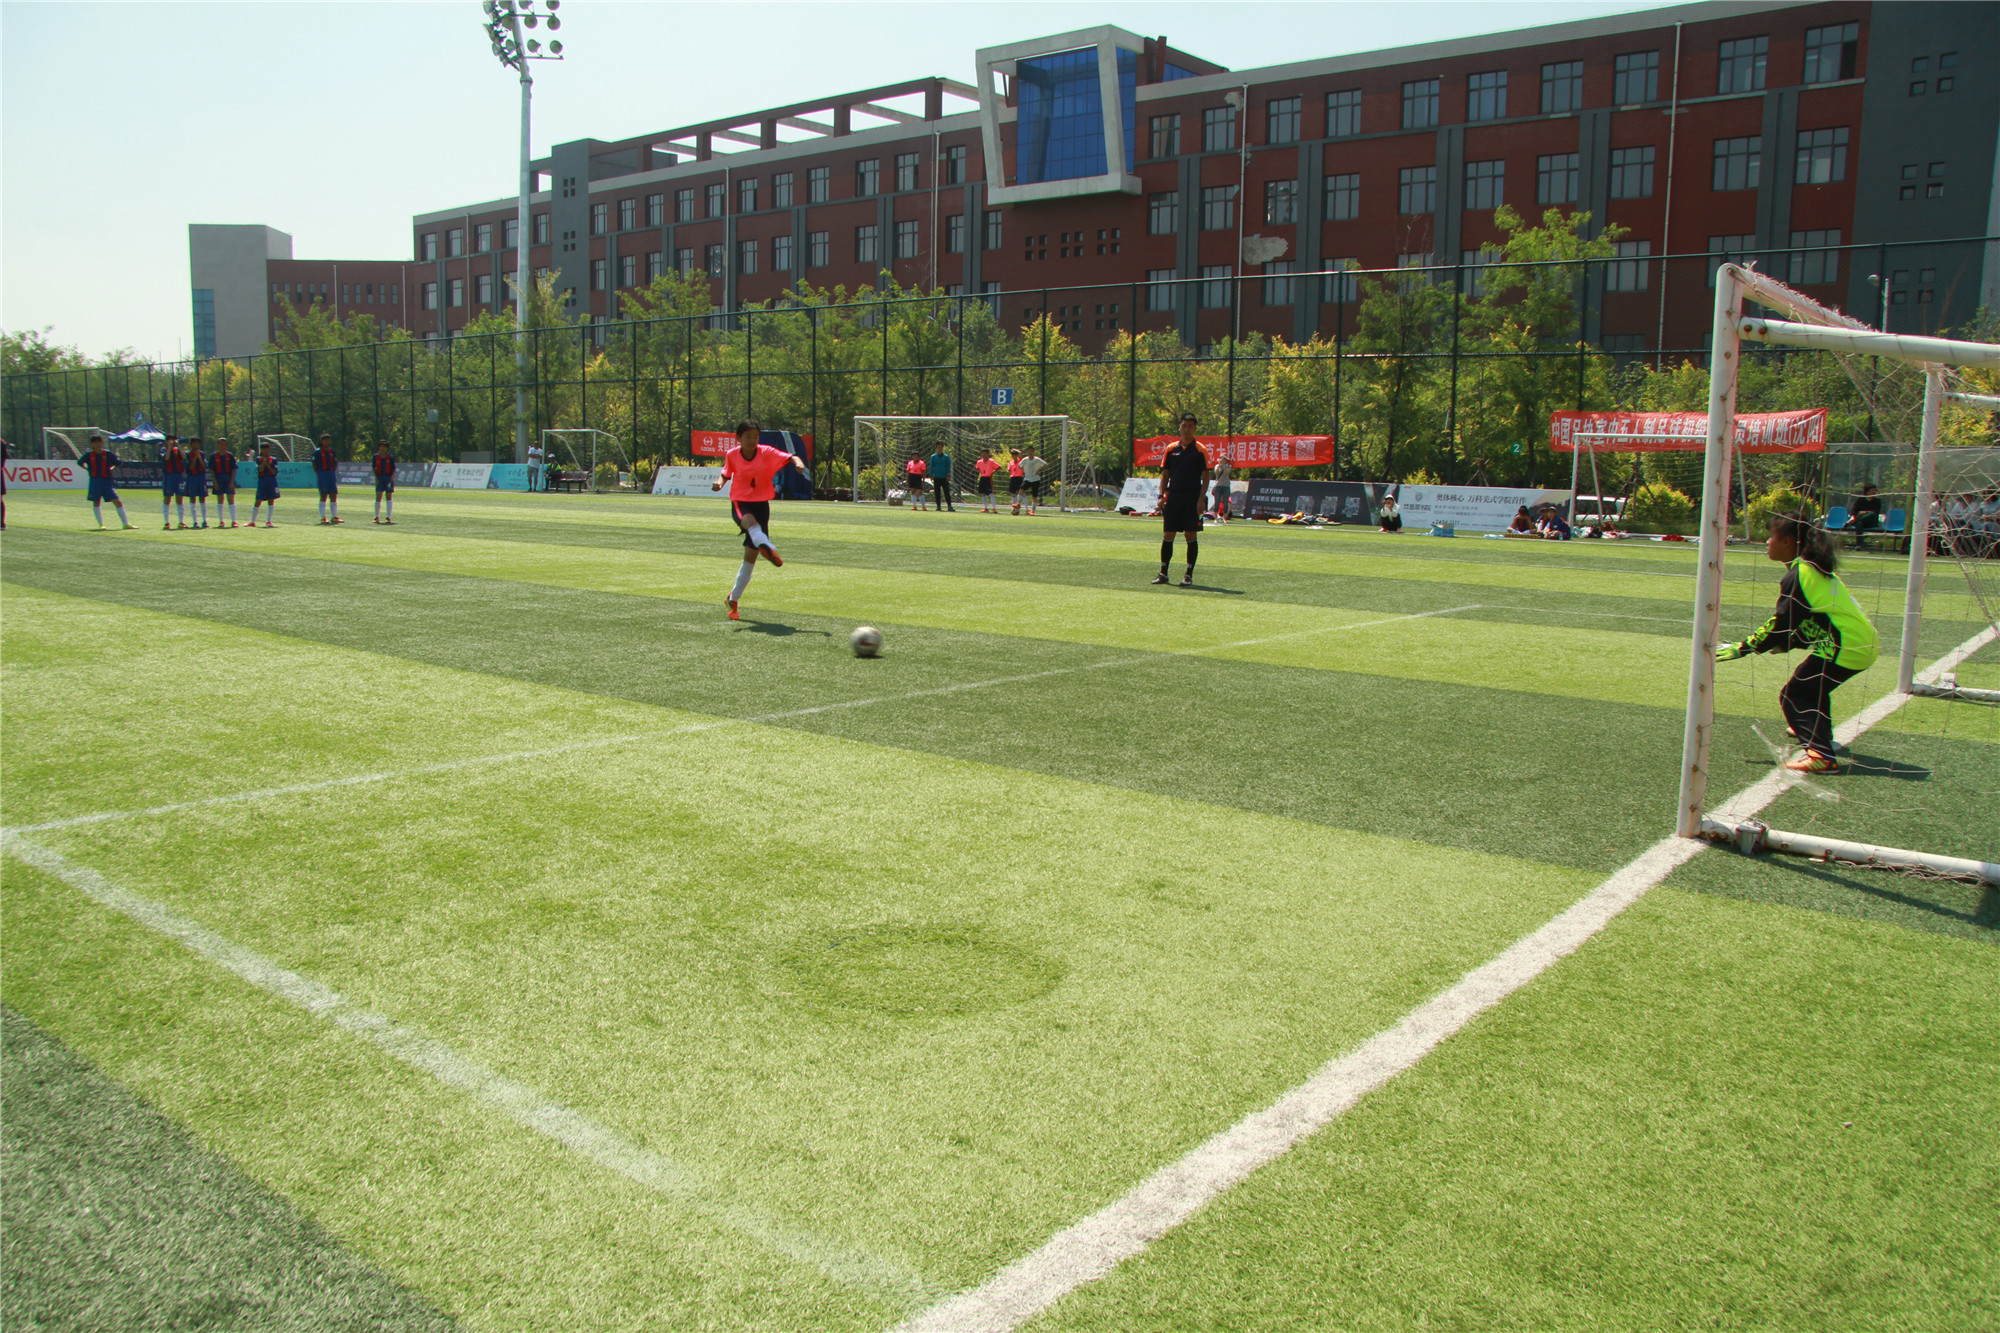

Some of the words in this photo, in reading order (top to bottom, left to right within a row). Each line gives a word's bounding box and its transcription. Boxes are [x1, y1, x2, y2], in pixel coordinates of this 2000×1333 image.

[997, 389, 1007, 404] B
[1513, 443, 1520, 453] 2
[3, 467, 73, 482] vanke
[750, 478, 756, 488] 4
